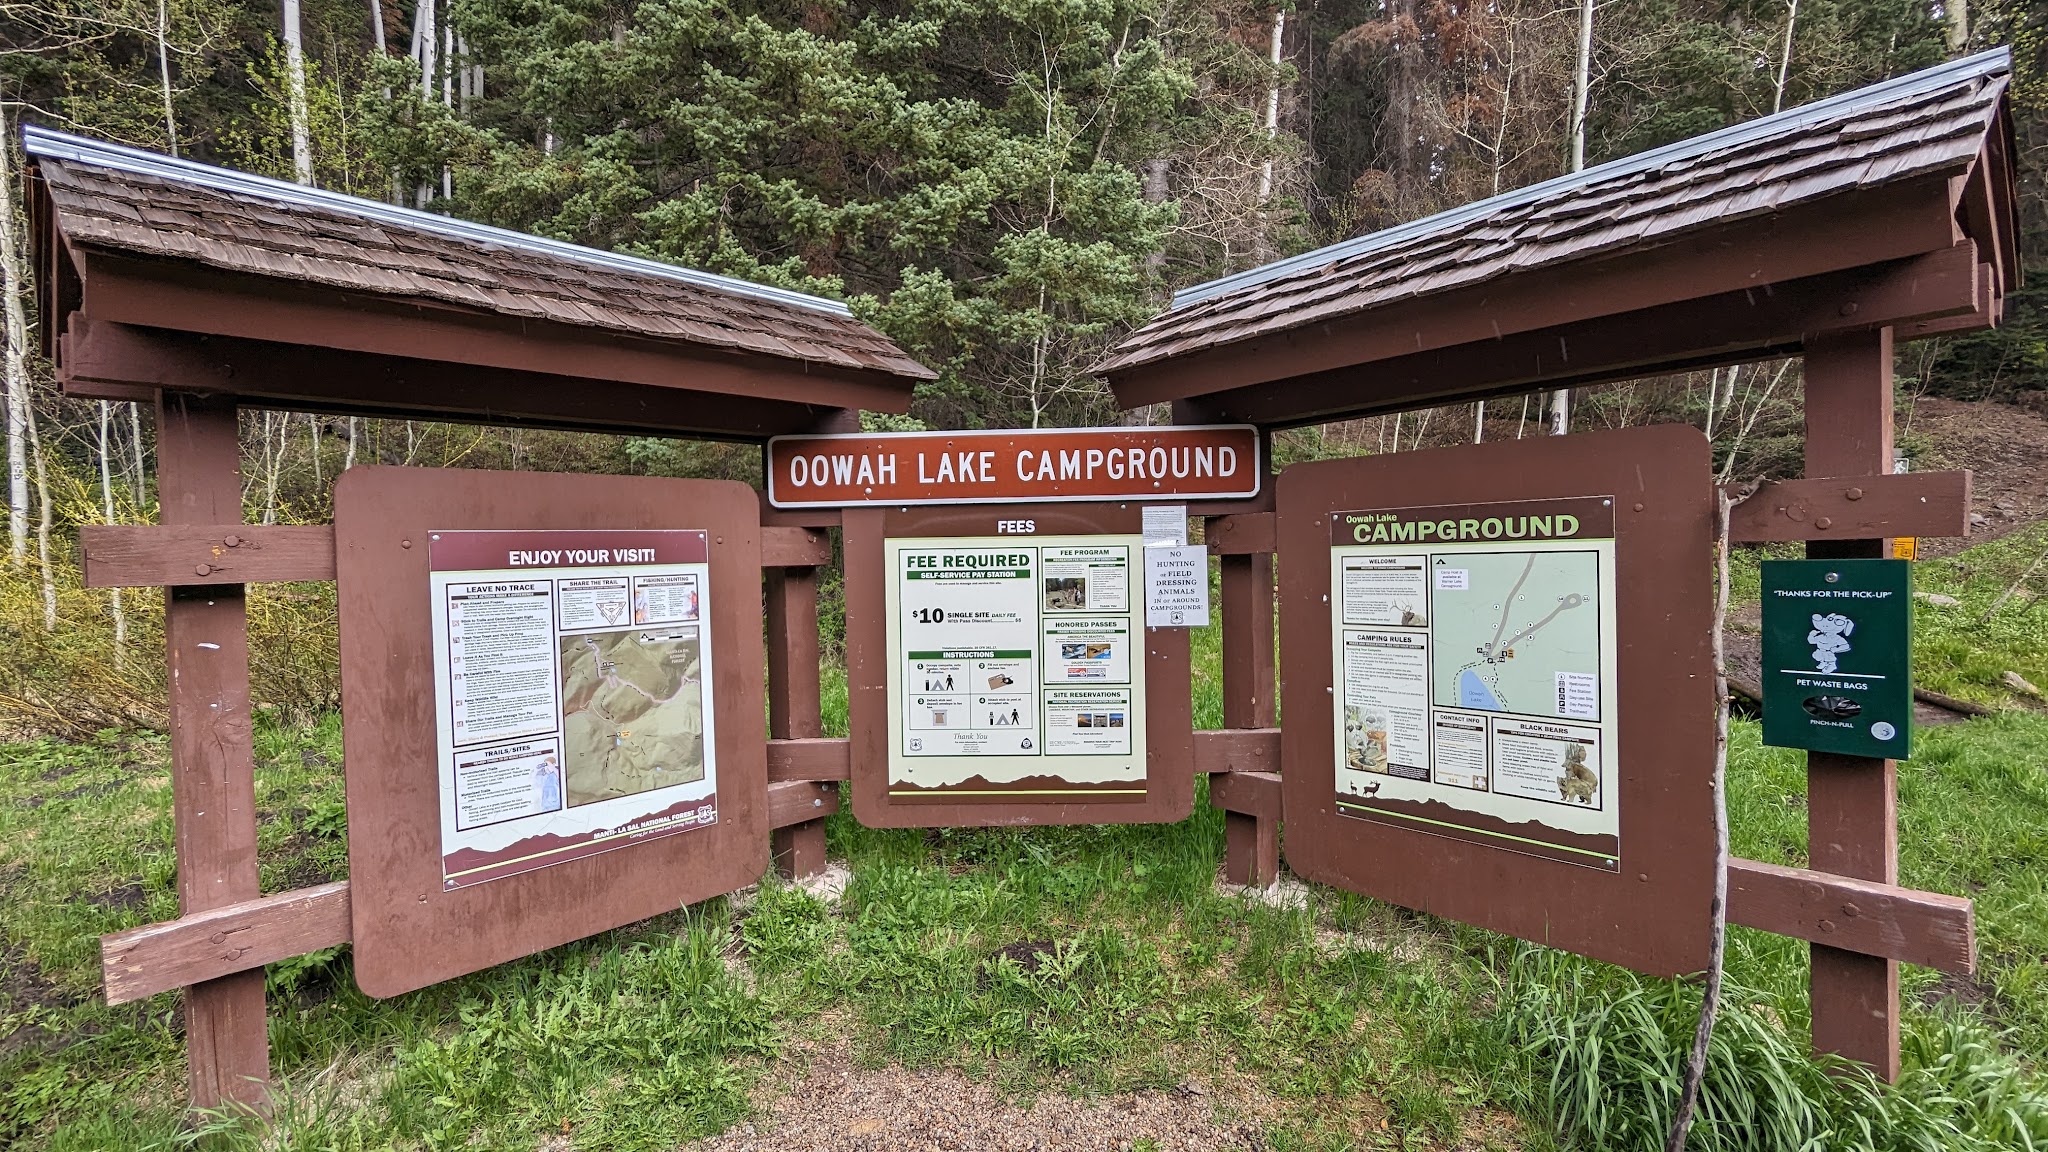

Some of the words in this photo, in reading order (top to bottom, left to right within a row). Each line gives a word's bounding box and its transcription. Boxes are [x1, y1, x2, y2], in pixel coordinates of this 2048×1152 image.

[790, 454, 896, 486] OOWAH
[918, 452, 995, 483] LAKE
[1016, 446, 1237, 482] CAMPGROUND
[1346, 514, 1374, 524] Oowah
[1376, 513, 1397, 522] Lake
[997, 520, 1036, 533] FEES
[1353, 514, 1580, 542] CAMPGROUND
[509, 551, 562, 565] ENJOY
[565, 550, 610, 564] YOUR
[613, 548, 656, 562] VISIT!
[907, 556, 938, 568] FEE
[942, 554, 1030, 569] REQUIRED
[1545, 726, 1568, 734] BEARS
[1810, 719, 1854, 728] PINCH-N-PULL
[485, 745, 530, 757] TRAILS/SITES
[640, 816, 671, 828] NATIONAL
[671, 810, 694, 820] FOREST
